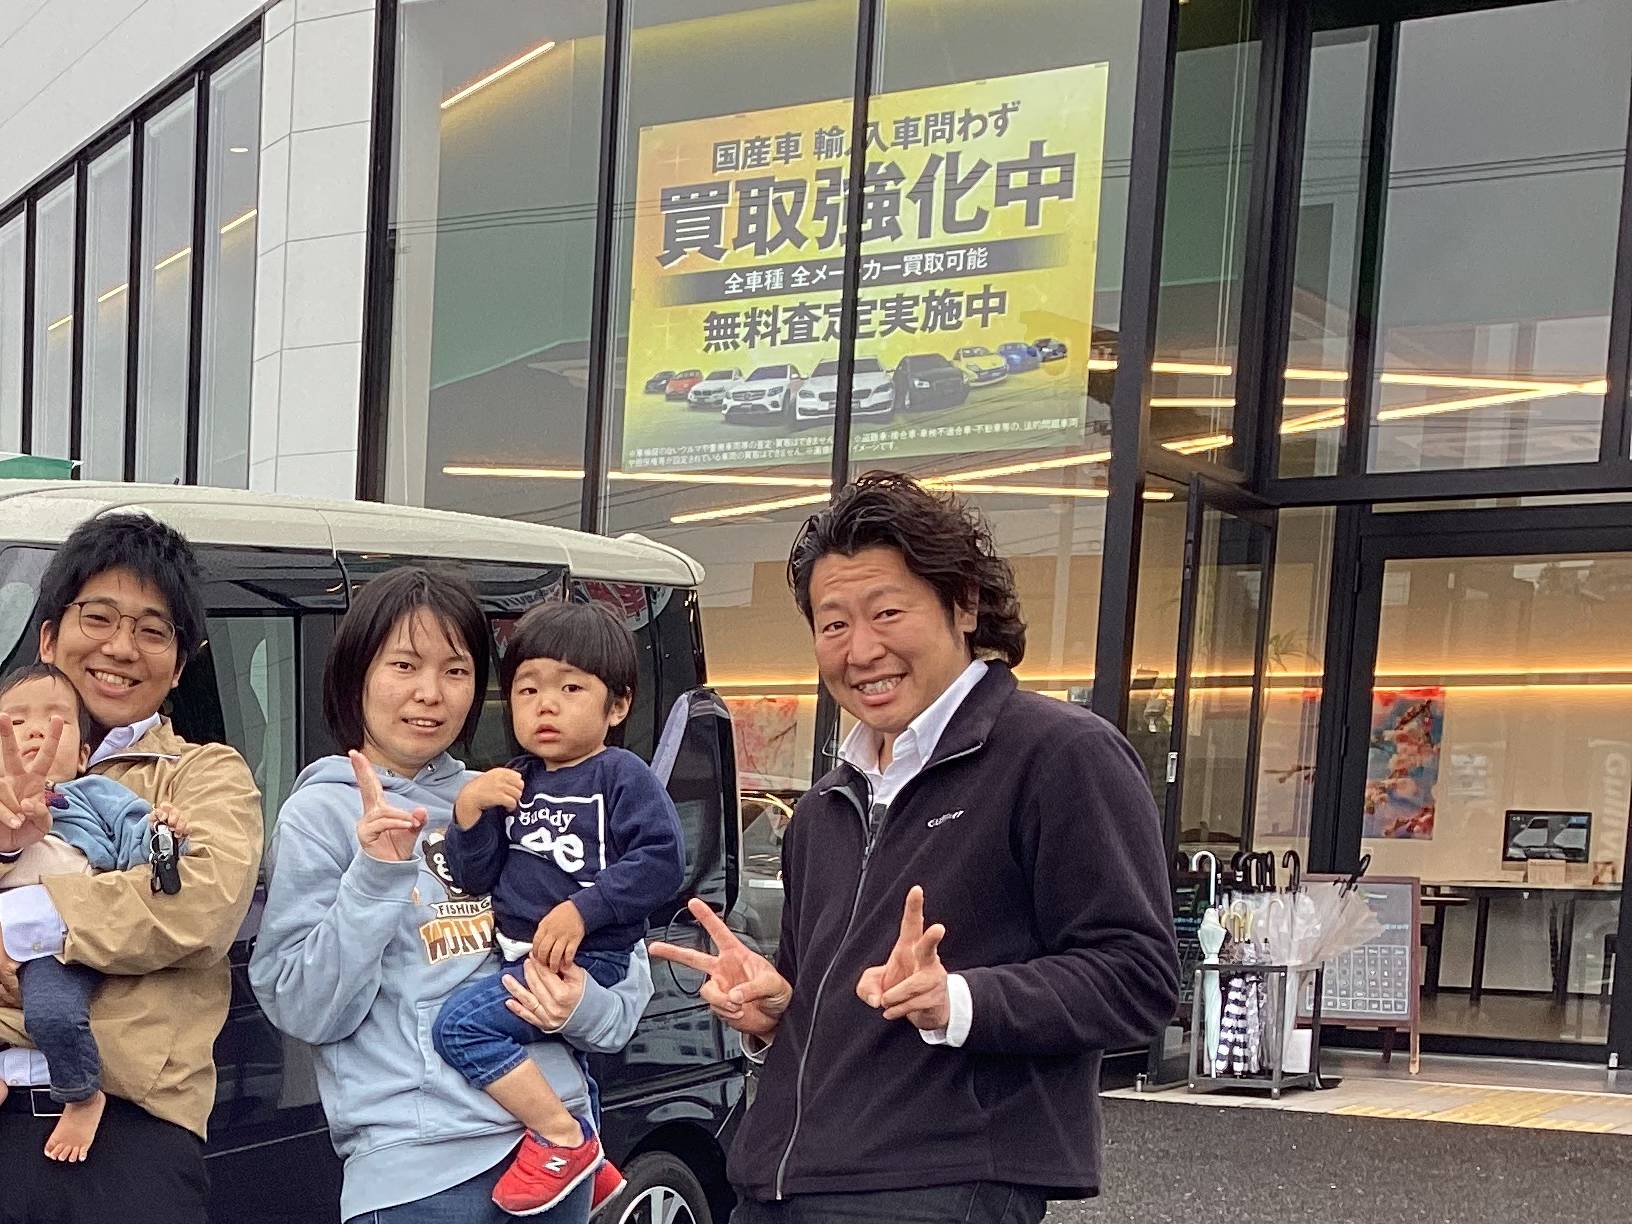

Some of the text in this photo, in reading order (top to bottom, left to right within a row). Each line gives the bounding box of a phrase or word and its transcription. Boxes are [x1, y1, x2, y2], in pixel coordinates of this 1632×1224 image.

[712, 100, 1021, 174] 国産車 輸入車問わず
[655, 138, 1077, 268] 買取強化中
[724, 267, 785, 295] 全車種
[703, 284, 1008, 352] 無料査定実施中
[519, 807, 577, 833] Buddy
[438, 899, 490, 916] FISHING
[544, 1156, 567, 1172] N
